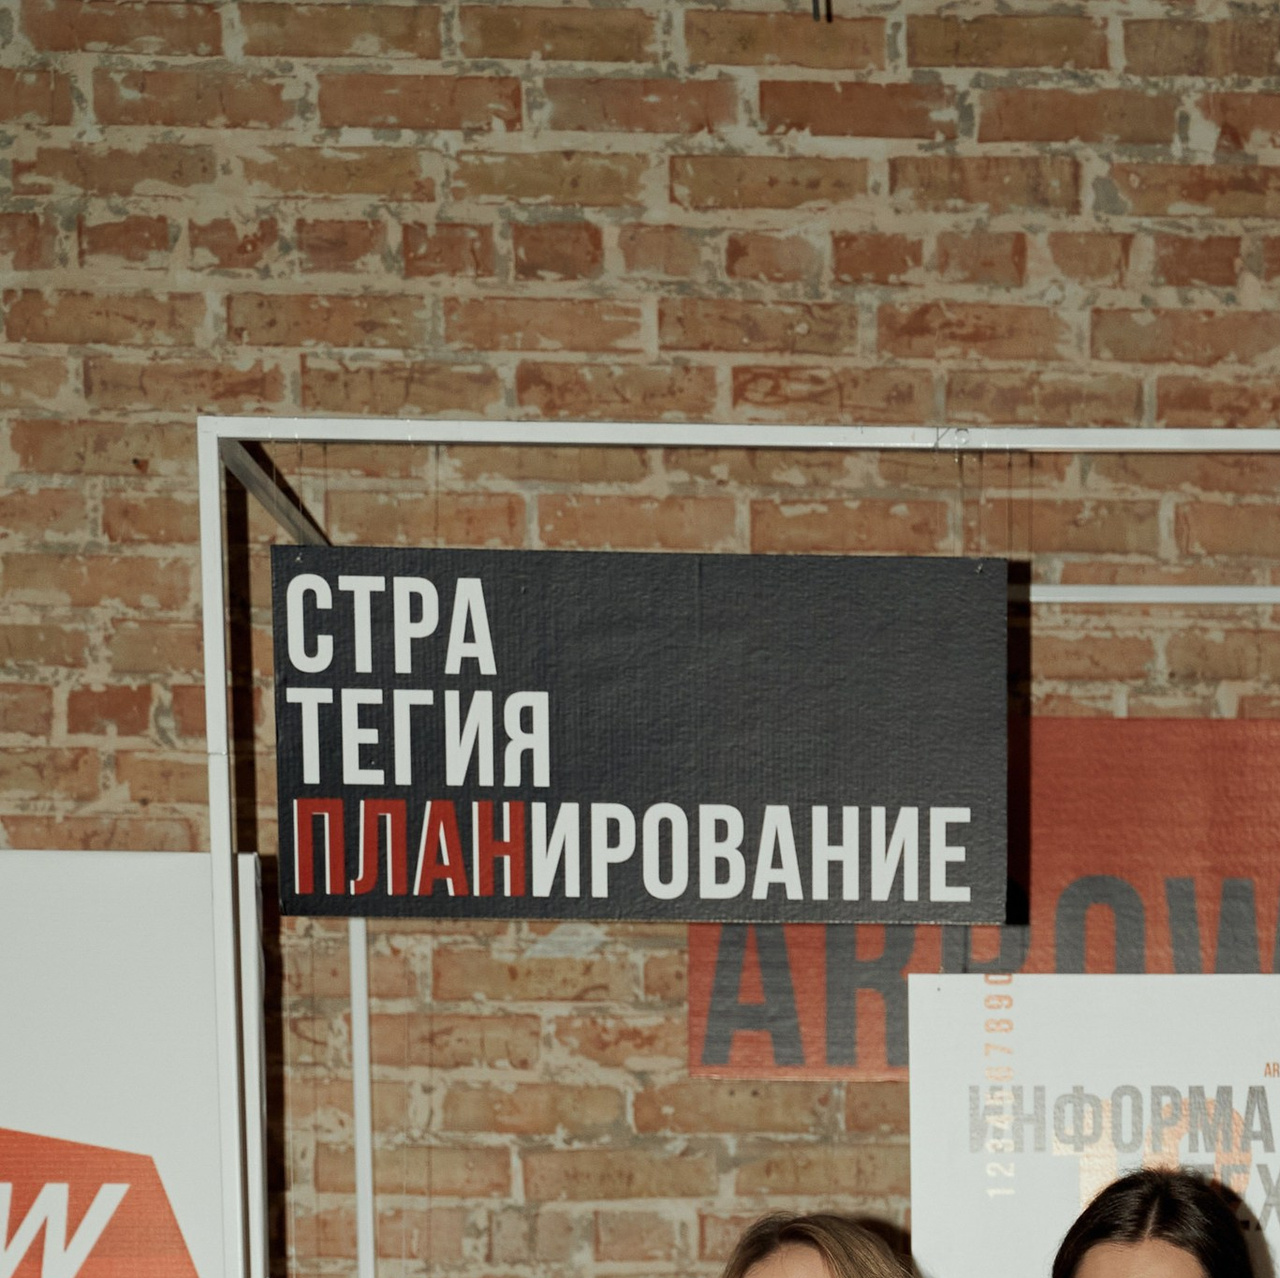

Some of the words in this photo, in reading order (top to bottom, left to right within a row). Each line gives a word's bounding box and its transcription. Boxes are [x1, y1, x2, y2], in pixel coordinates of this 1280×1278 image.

[286, 574, 497, 675] СТРА
[286, 688, 551, 788] ТЕГИЯ
[293, 799, 971, 902] ПЛАНИРОВАНИЕ
